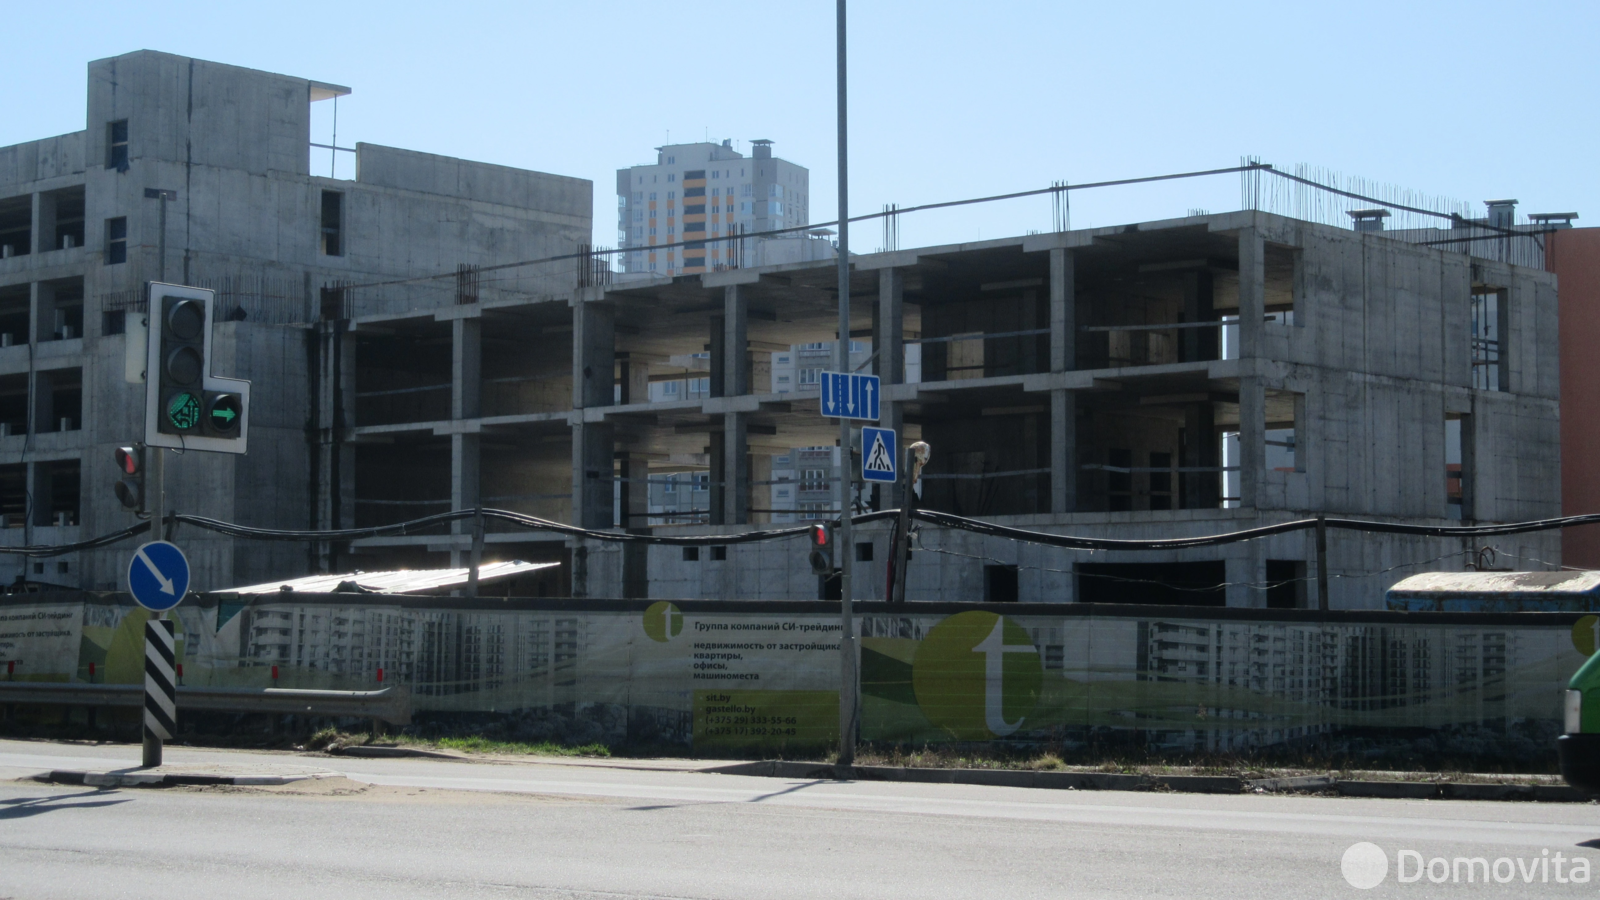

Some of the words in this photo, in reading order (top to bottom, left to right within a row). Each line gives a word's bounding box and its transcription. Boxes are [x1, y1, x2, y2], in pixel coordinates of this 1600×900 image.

[694, 621, 729, 633] Группа
[731, 622, 780, 632] компаний
[693, 642, 765, 651] недвижимость
[766, 643, 777, 651] от
[693, 652, 744, 661] квартиры,
[693, 662, 728, 671] офисы,
[693, 672, 760, 680] машиноместа
[705, 693, 731, 704] sit.by
[705, 705, 756, 715] gastello.by
[705, 716, 732, 725] (+375
[734, 716, 749, 725] 29)
[750, 716, 797, 725] 333-55-66
[705, 727, 732, 736] (+375
[735, 727, 749, 736] 17)
[750, 727, 797, 736] 392-20-45
